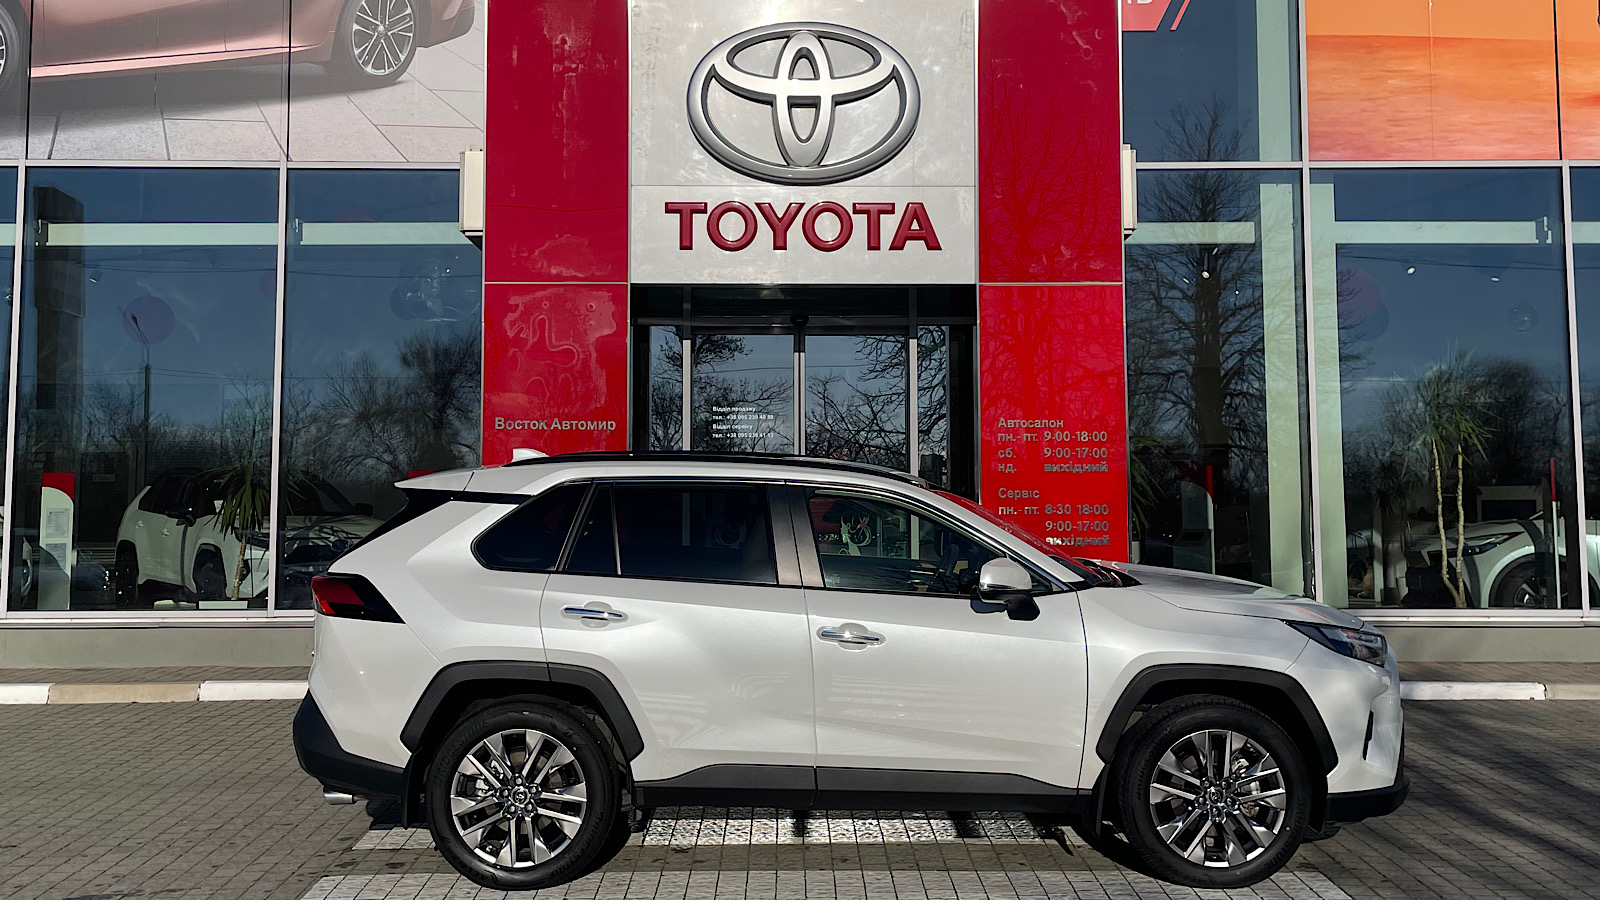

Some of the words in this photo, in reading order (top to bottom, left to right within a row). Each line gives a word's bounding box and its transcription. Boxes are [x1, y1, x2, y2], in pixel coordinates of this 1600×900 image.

[665, 201, 942, 252] TOYOTA
[494, 416, 548, 431] Восток
[550, 418, 616, 434] Автомир
[998, 417, 1064, 428] Автосалон
[998, 447, 1017, 458] сб.
[1043, 447, 1108, 458] 9:00-17:00
[998, 463, 1017, 473] нд.
[1044, 461, 1109, 473] вихідний
[998, 487, 1040, 500] Сервіс
[1045, 521, 1109, 531] 9:00-17:00
